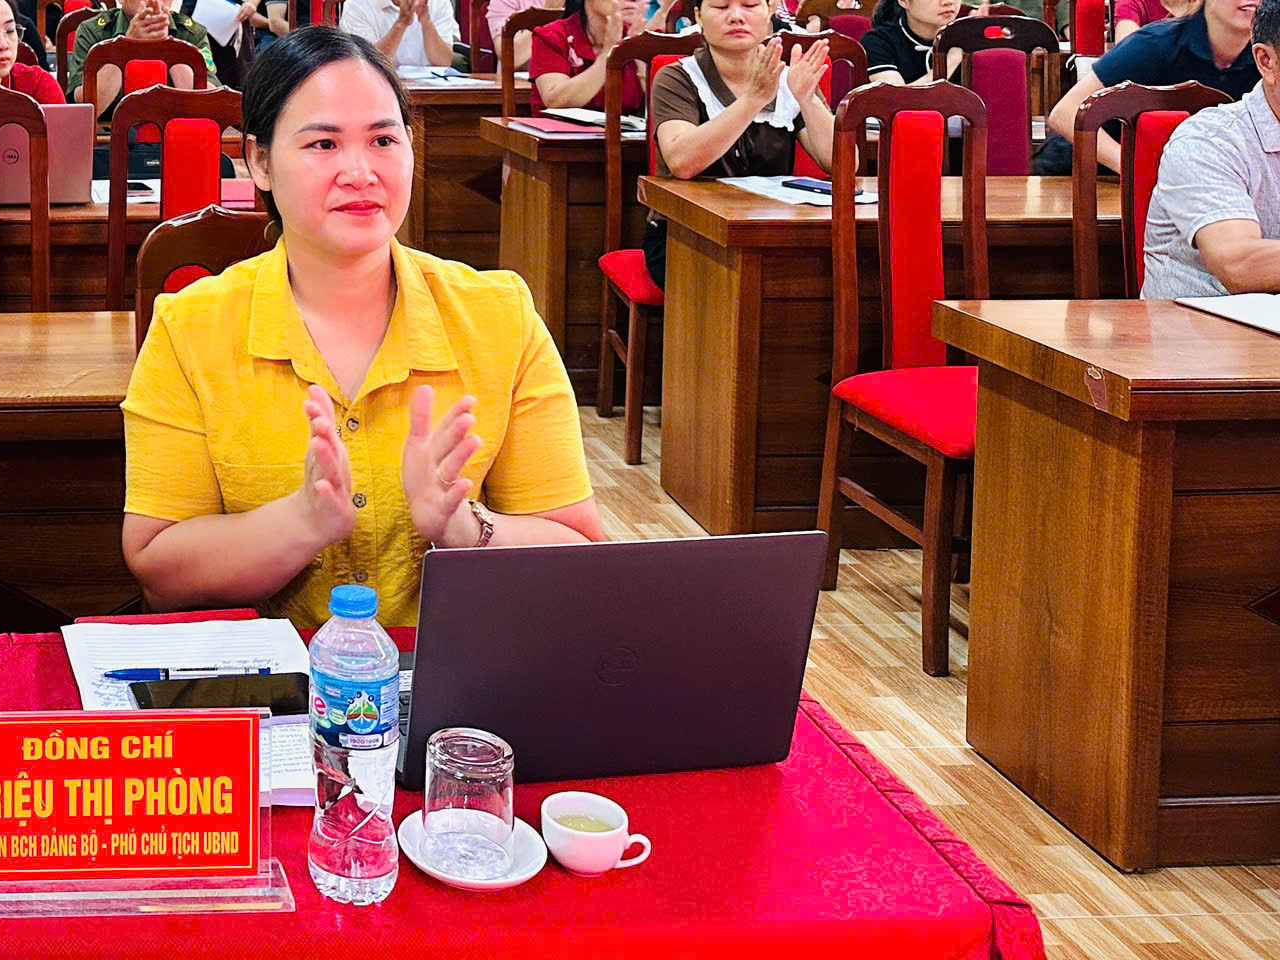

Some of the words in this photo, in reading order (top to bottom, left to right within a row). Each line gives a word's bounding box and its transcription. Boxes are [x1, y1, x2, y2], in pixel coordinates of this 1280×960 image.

[22, 729, 110, 761] ĐỒNG
[120, 730, 173, 759] CHÍ
[63, 777, 113, 825] THỊ
[124, 768, 233, 817] PHÒNG
[11, 835, 38, 858] BCH
[41, 827, 77, 857] ĐẢNG
[81, 829, 98, 861] BỘ
[111, 828, 138, 856] PHÓ
[141, 825, 167, 855] CHỦ
[171, 831, 200, 860] TỊCH
[203, 831, 239, 854] UBND
